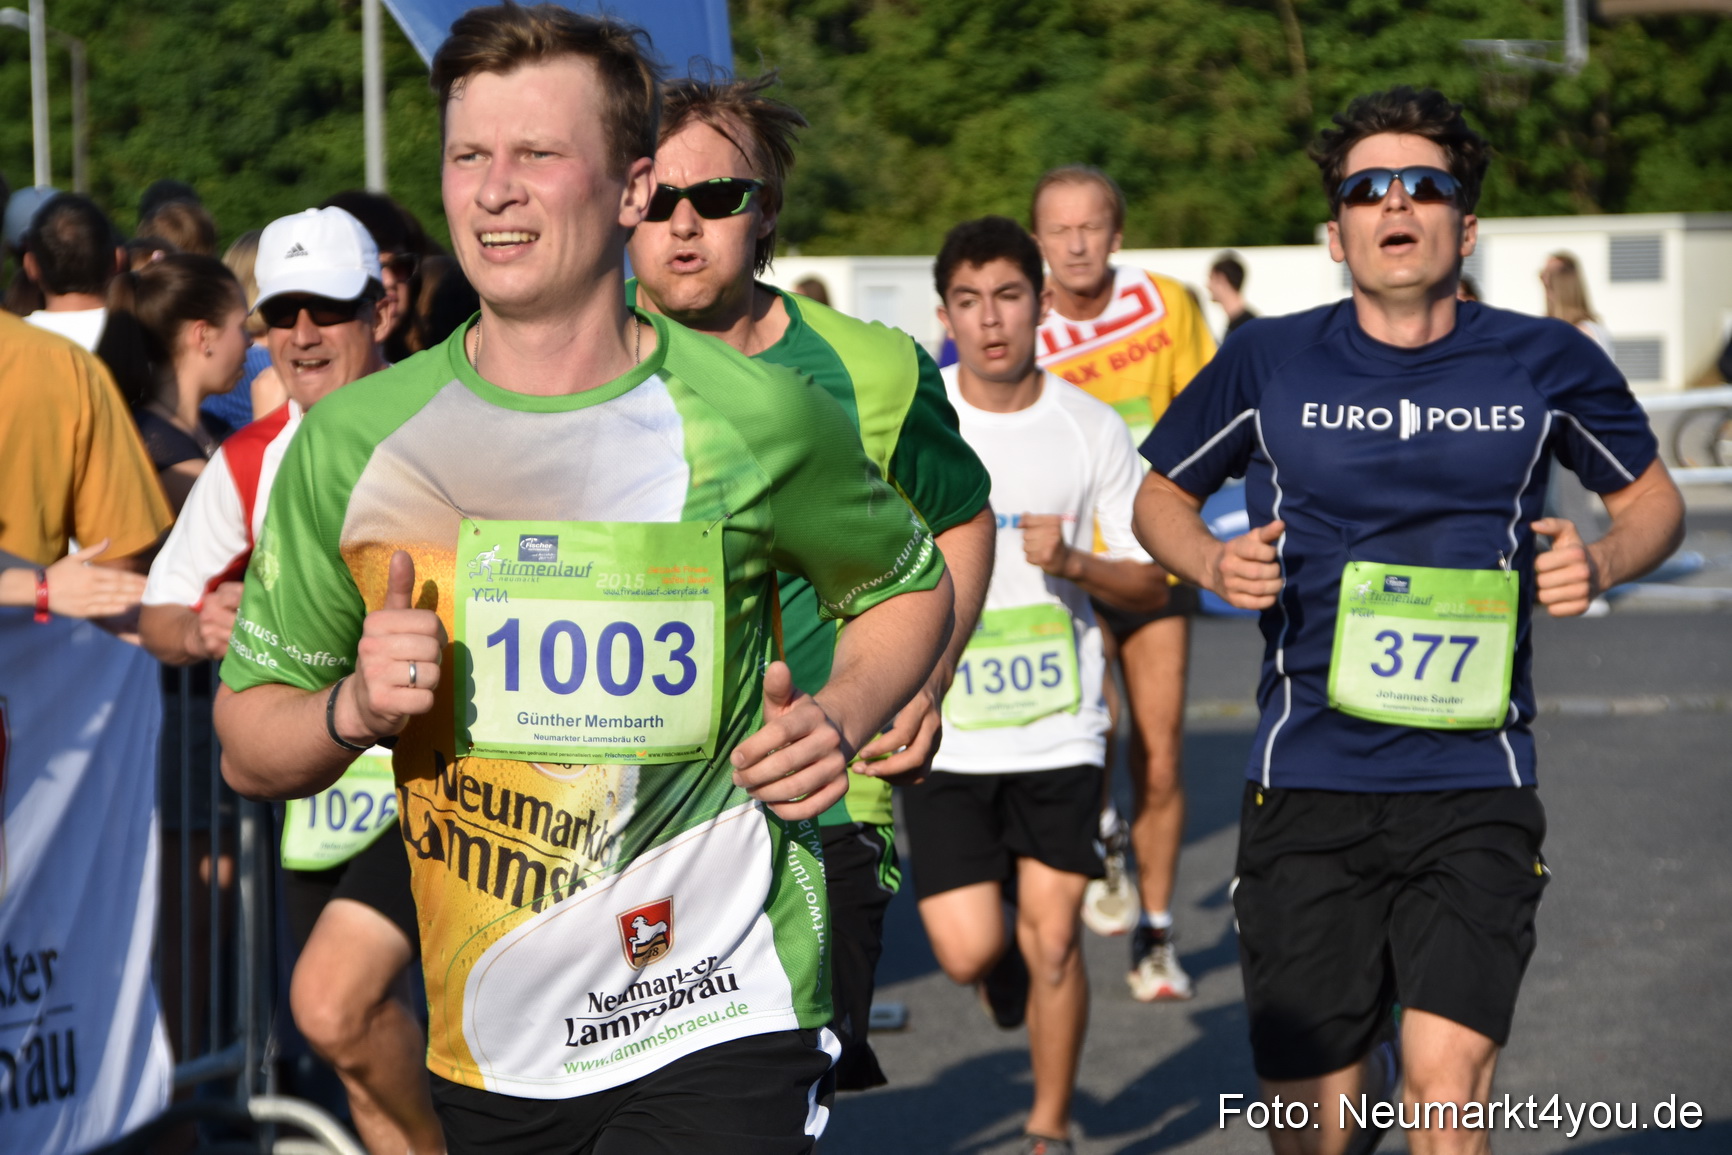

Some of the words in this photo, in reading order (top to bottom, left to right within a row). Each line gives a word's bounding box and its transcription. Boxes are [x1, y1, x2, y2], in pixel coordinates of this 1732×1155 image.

[1302, 402, 1393, 431] EURO
[1427, 405, 1526, 431] POLES
[500, 559, 594, 578] firmenlauf
[595, 572, 646, 588] 2015
[486, 618, 698, 696] 1003
[1370, 629, 1479, 683] 377
[956, 651, 1063, 695] 1305
[1376, 690, 1429, 703] Johannes
[1430, 694, 1464, 704] Sauter
[516, 711, 582, 728] Günther
[585, 714, 664, 728] Membarth
[533, 733, 581, 742] Neumarkter
[582, 734, 632, 743] Lammsbräu
[633, 735, 646, 743] KG
[301, 788, 397, 832] 1026
[563, 1001, 749, 1074] www.lammsbraeu.de
